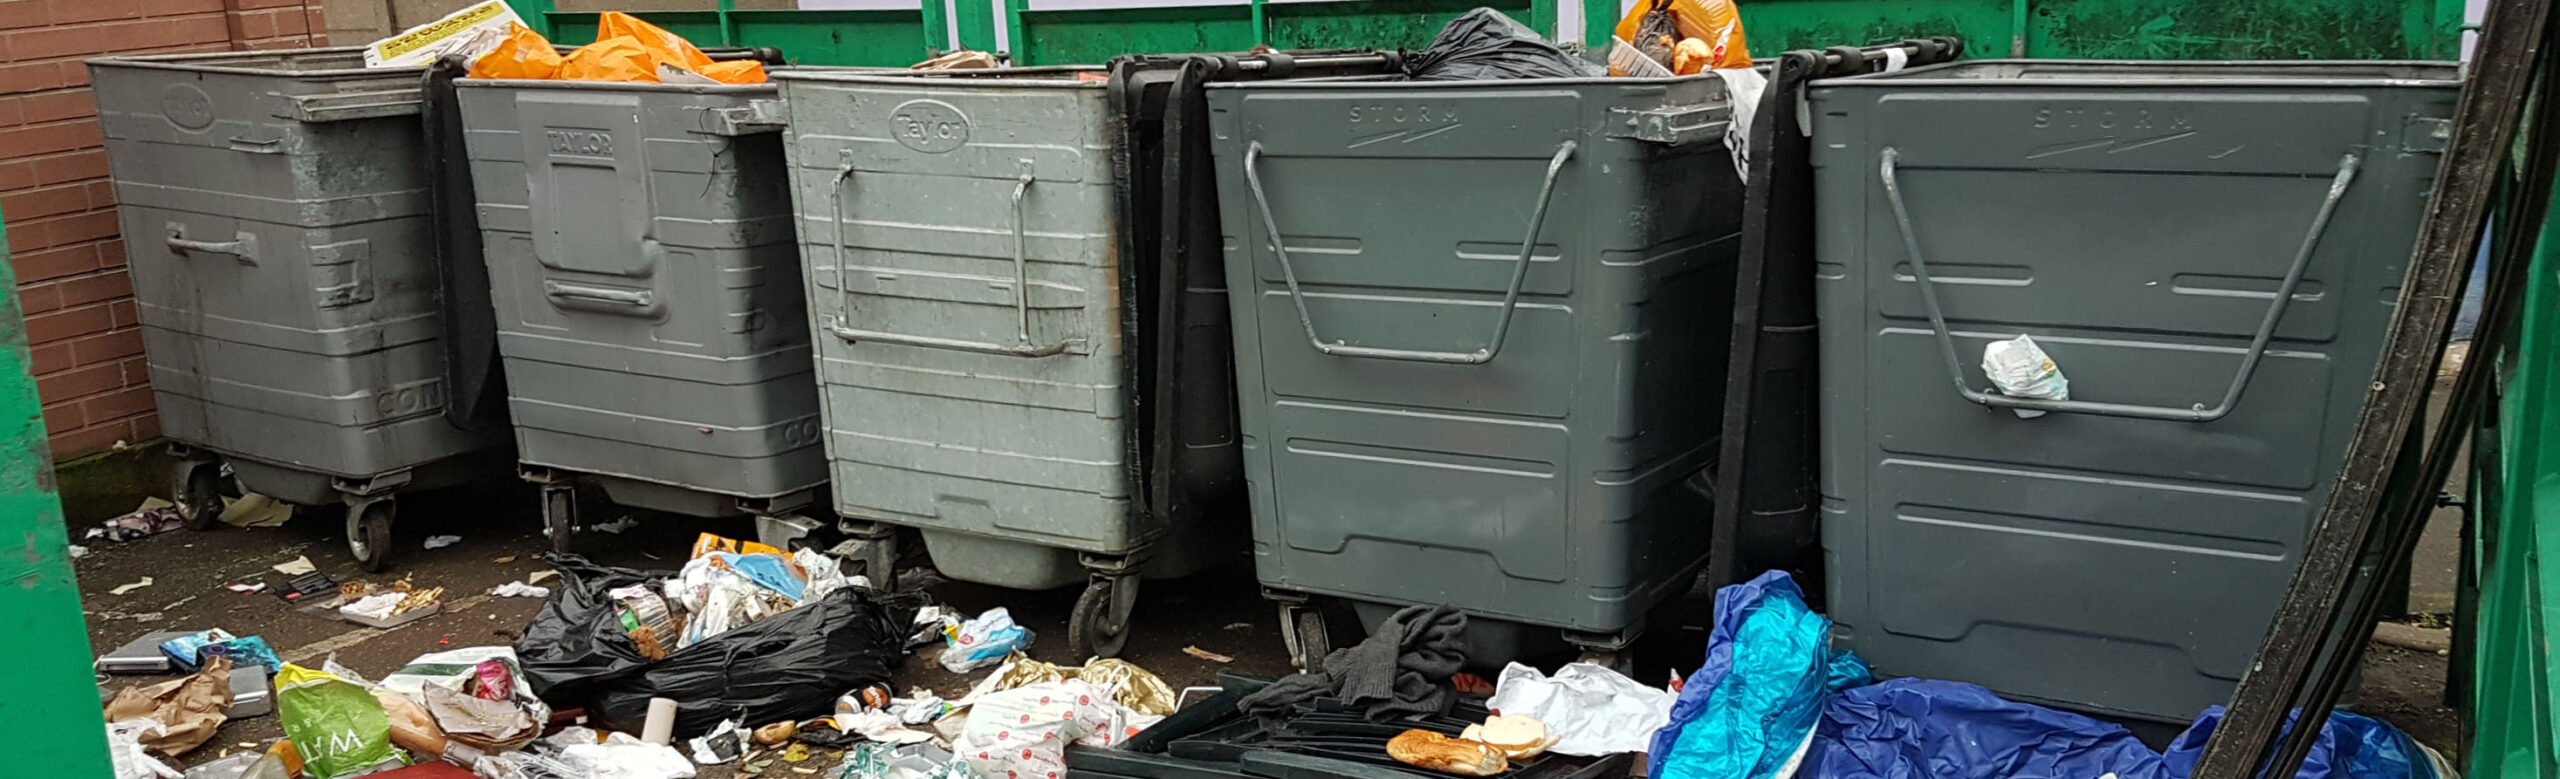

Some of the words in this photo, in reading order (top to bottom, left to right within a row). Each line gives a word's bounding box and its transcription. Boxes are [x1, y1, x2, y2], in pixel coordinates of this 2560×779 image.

[1347, 105, 1459, 123] STORM
[2033, 107, 2193, 130] STORM
[896, 114, 961, 144] Taylor
